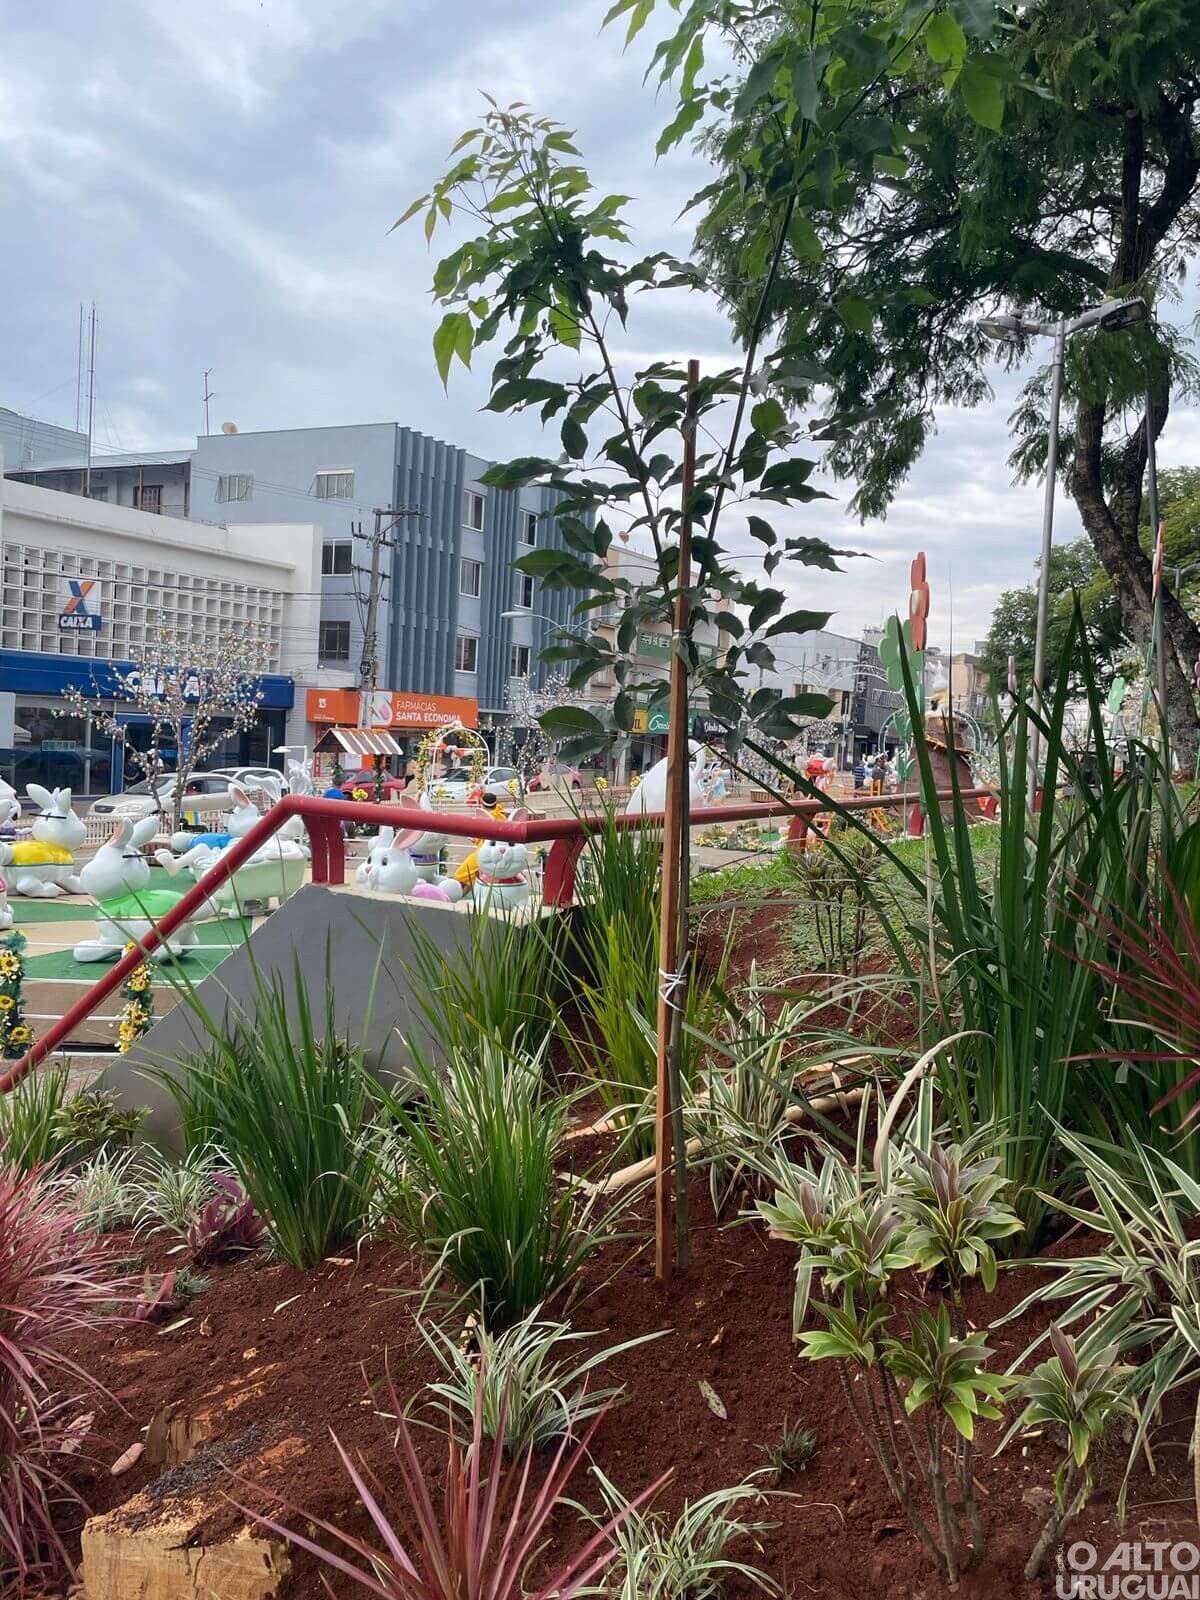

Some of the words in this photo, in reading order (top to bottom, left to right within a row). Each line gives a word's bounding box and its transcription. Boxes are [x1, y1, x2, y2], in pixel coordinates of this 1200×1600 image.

[60, 616, 93, 628] CAIXA
[396, 711, 422, 721] SANTA
[424, 713, 460, 723] ECONOMIA
